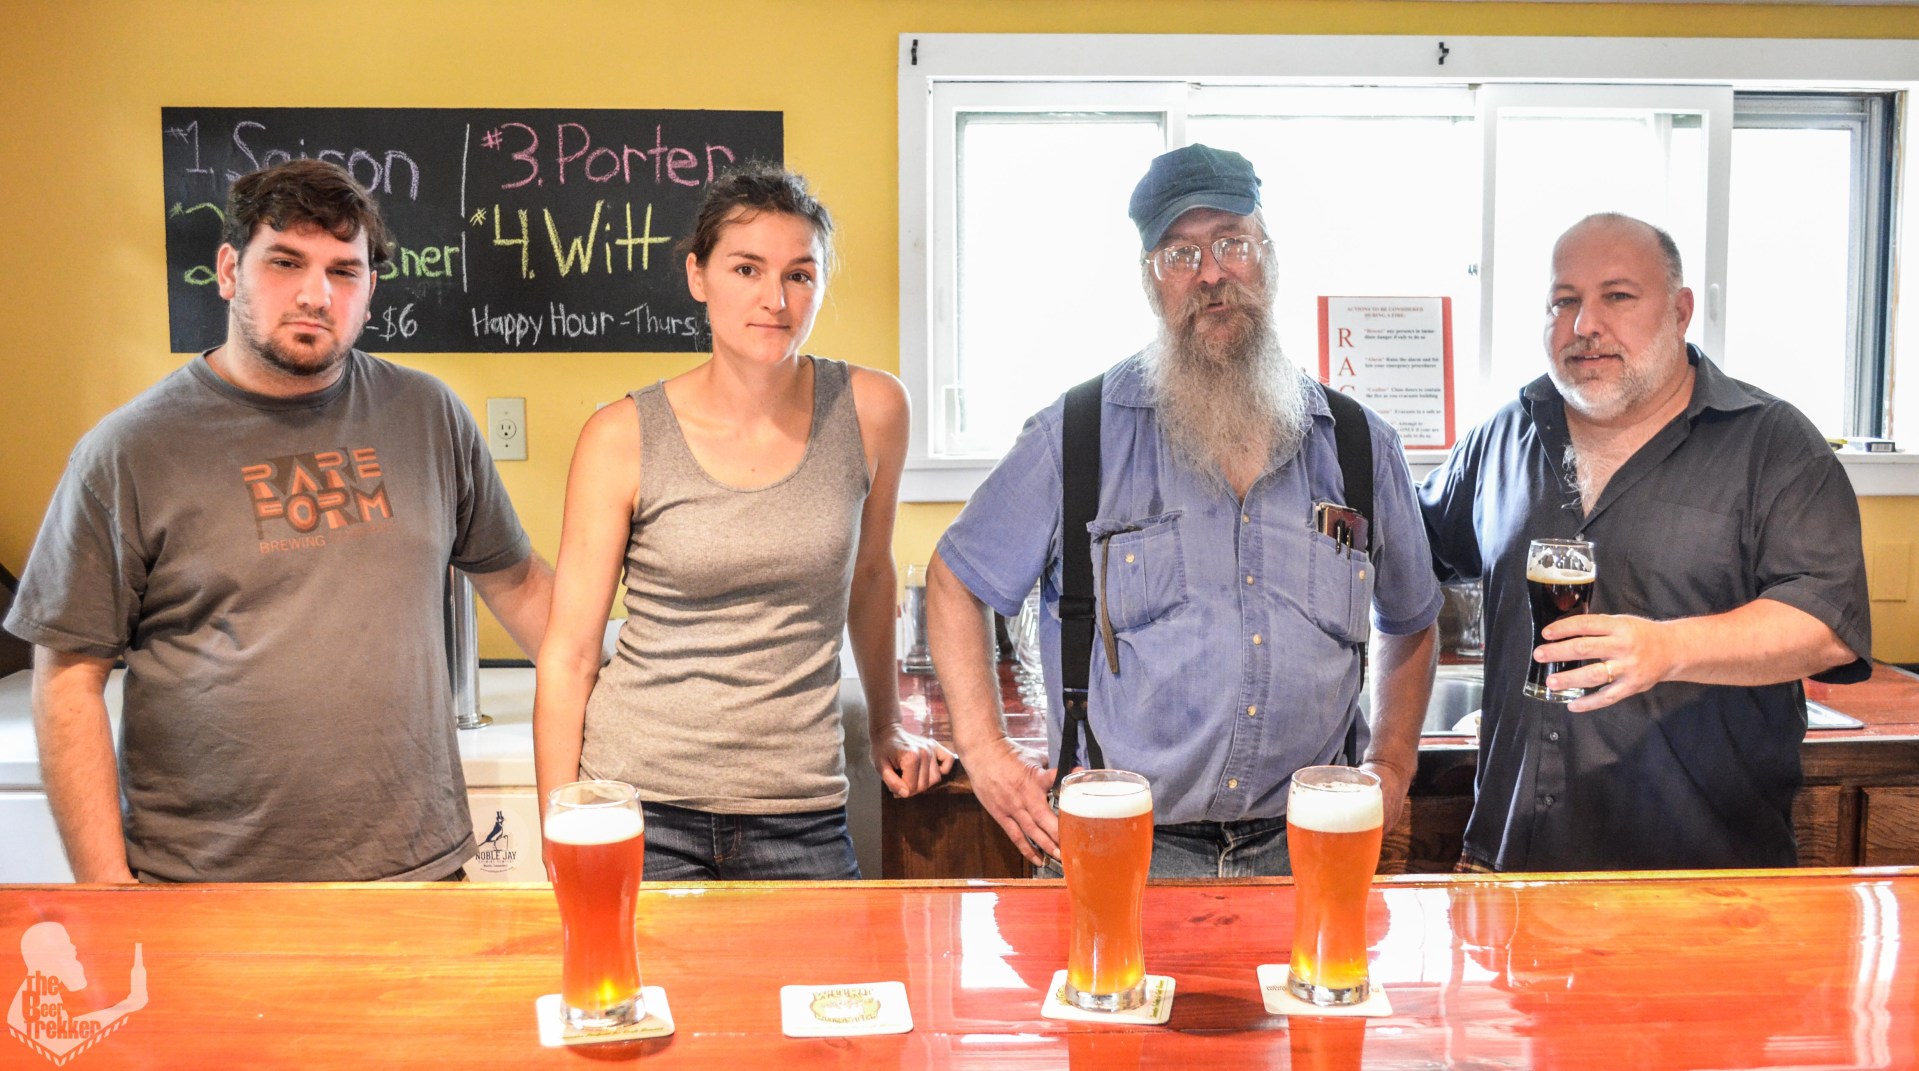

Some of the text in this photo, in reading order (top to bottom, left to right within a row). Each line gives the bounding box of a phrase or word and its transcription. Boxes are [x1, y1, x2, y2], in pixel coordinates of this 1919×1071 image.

[480, 121, 736, 190] #3. Porter
[469, 199, 672, 279] #4. Witt
[471, 303, 543, 347] Happy
[550, 301, 615, 338] Hour
[1337, 327, 1355, 348] R
[1338, 356, 1356, 376] A
[240, 447, 383, 499] RARE
[252, 481, 394, 540] FORM
[258, 534, 327, 555] BREWING
[475, 850, 517, 861] NOBLE JAY
